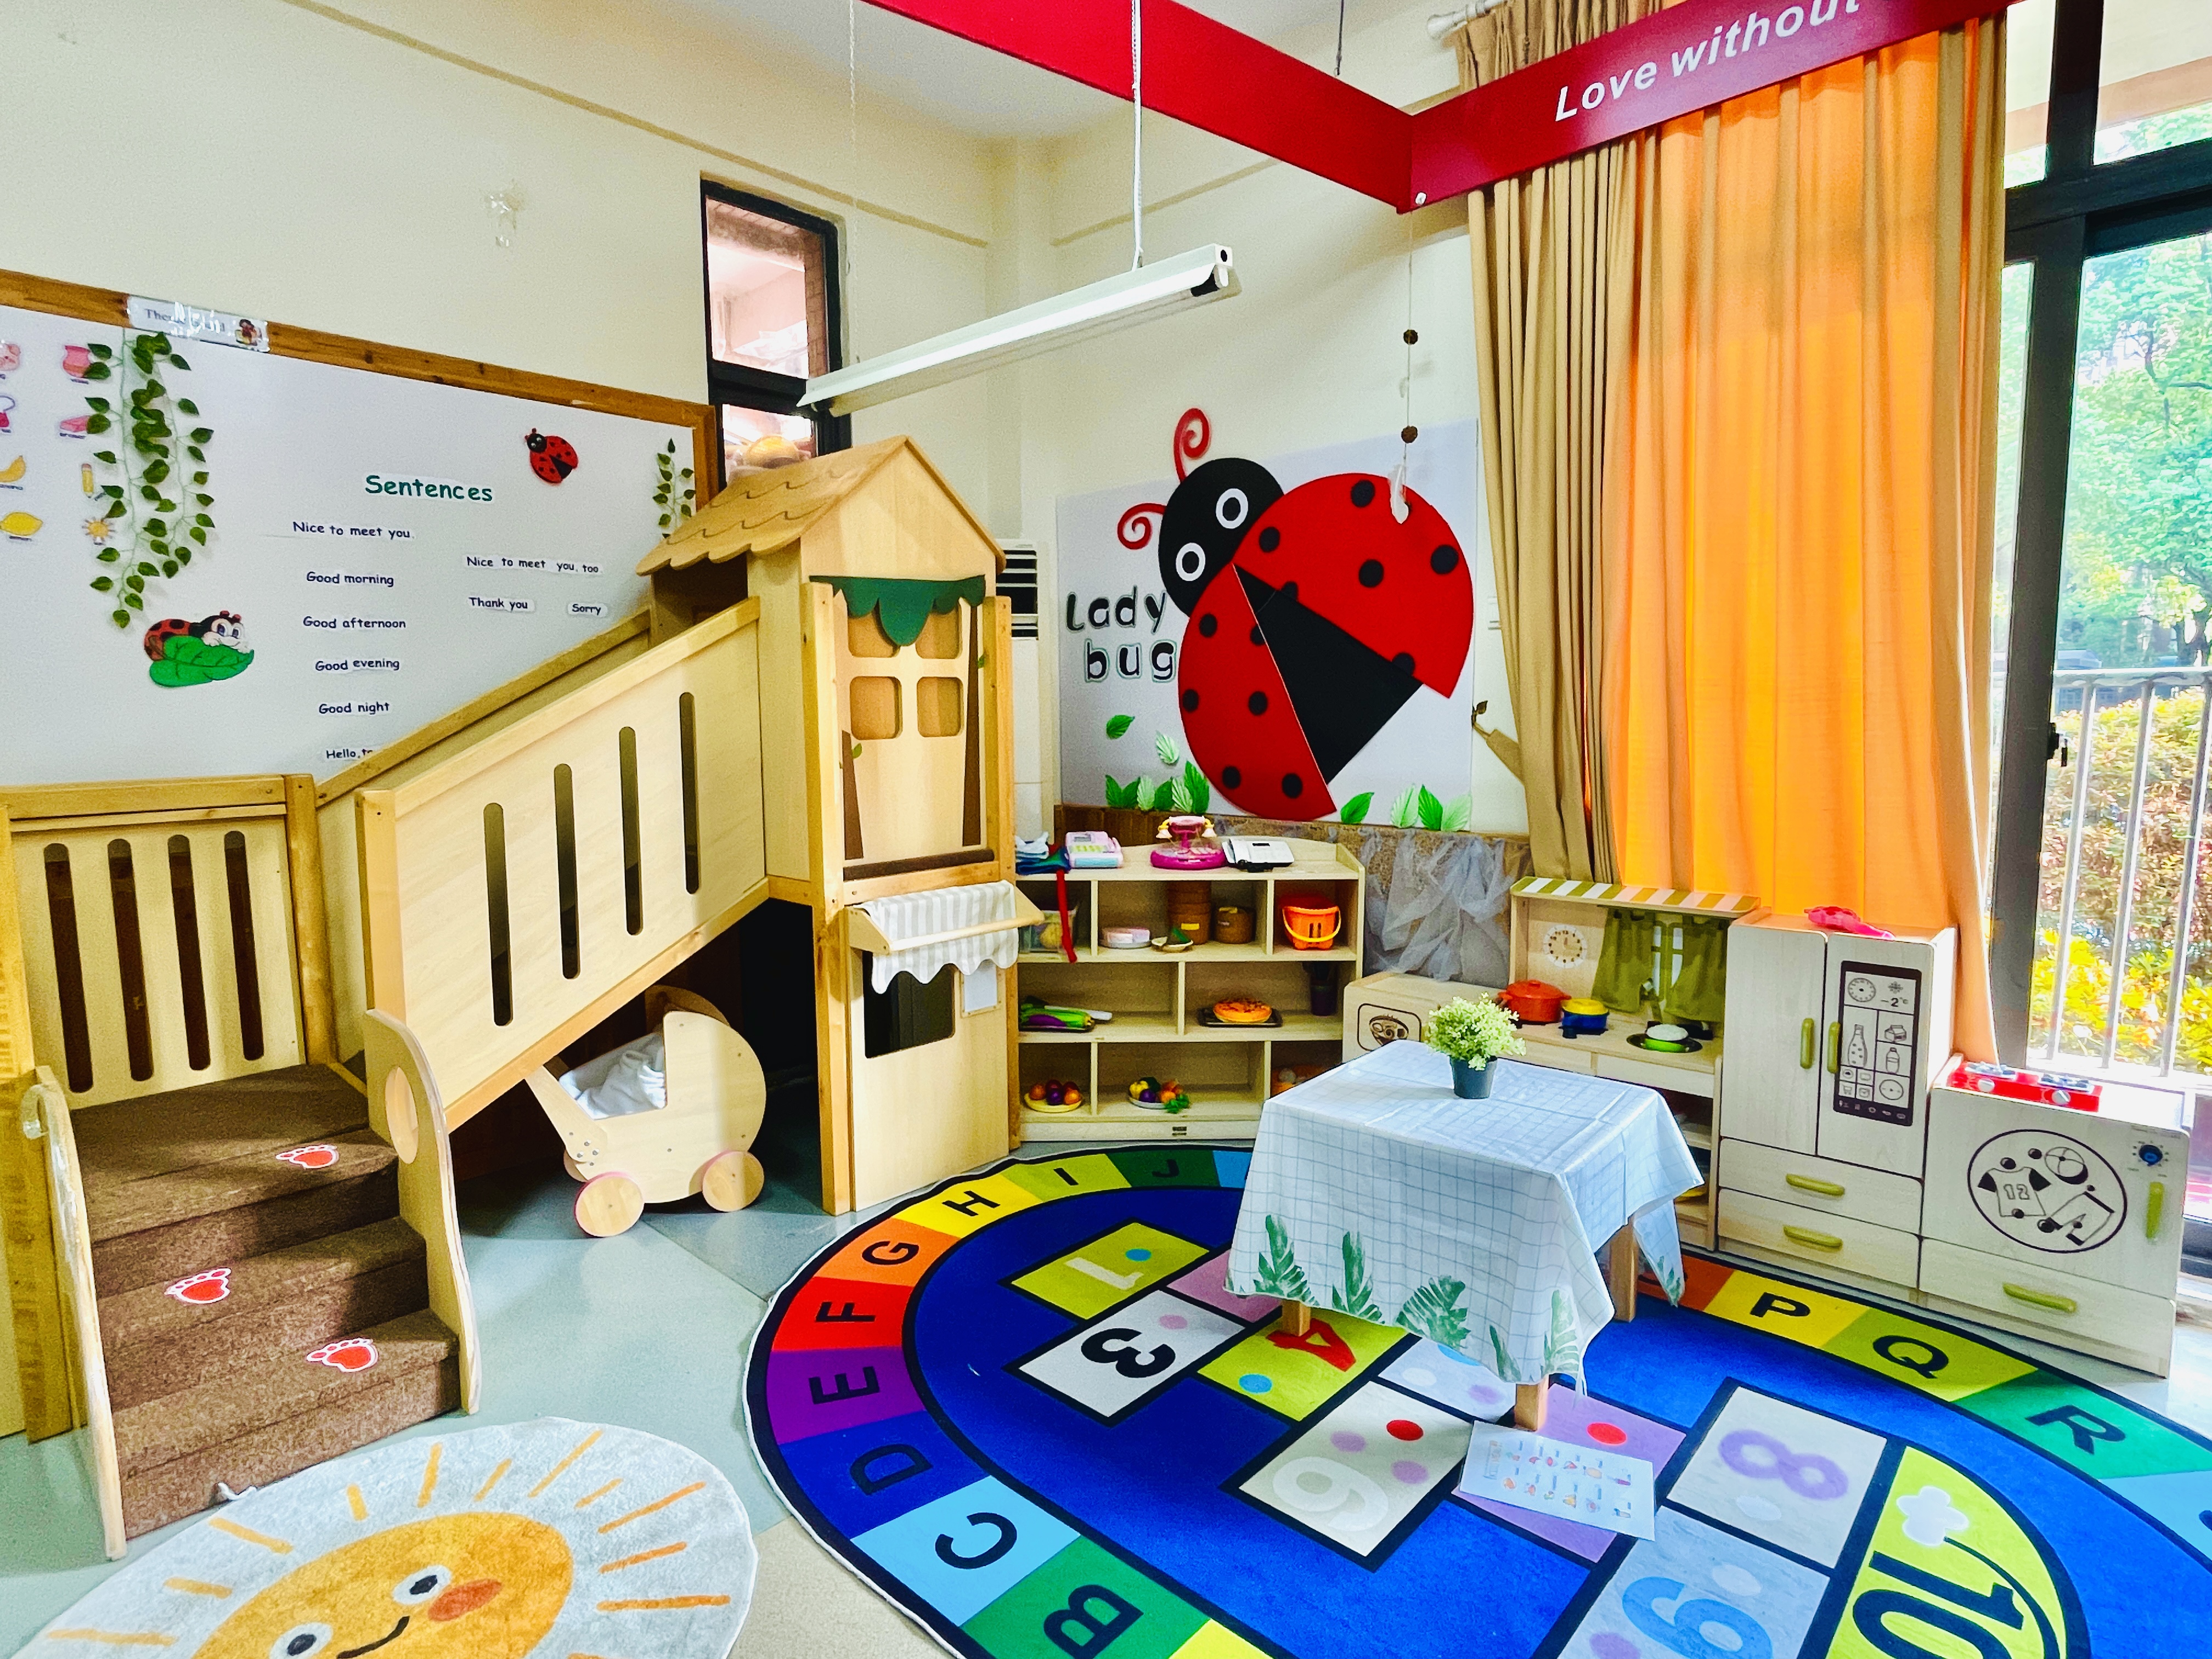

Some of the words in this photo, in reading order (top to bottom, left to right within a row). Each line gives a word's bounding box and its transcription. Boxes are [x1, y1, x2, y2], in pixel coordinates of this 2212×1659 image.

[1555, 61, 1657, 122] Love
[1671, 0, 1861, 78] without
[365, 475, 493, 501] Sentences
[292, 521, 325, 533] Nice
[329, 525, 344, 535] to
[350, 527, 383, 537] meet
[466, 556, 494, 567] Nice
[501, 557, 514, 567] to
[518, 560, 546, 568] meet
[306, 572, 340, 584] Good
[343, 574, 394, 588] morning
[468, 597, 505, 608] Thank
[509, 601, 528, 611] you
[572, 603, 601, 616] Sorry
[303, 616, 337, 629] Good
[342, 617, 406, 629] afternoon
[315, 660, 349, 672] Good
[352, 658, 400, 671] evening
[1086, 640, 1175, 682] bug
[318, 702, 352, 714] Good
[358, 701, 390, 715] night
[1152, 1159, 1180, 1178] J
[941, 1190, 1000, 1217] H
[2003, 1183, 2030, 1200] 12
[861, 1240, 920, 1266] G
[815, 1301, 877, 1323] F
[1749, 1291, 1811, 1320] P
[1081, 1328, 1176, 1379] 3
[1872, 1335, 1950, 1380] Q
[809, 1365, 881, 1404] E
[2025, 1404, 2126, 1455] R
[849, 1443, 934, 1496] D
[1718, 1429, 1849, 1500] 8
[934, 1511, 1018, 1570] C
[1852, 1550, 2024, 1659] 10
[1043, 1584, 1145, 1659] B
